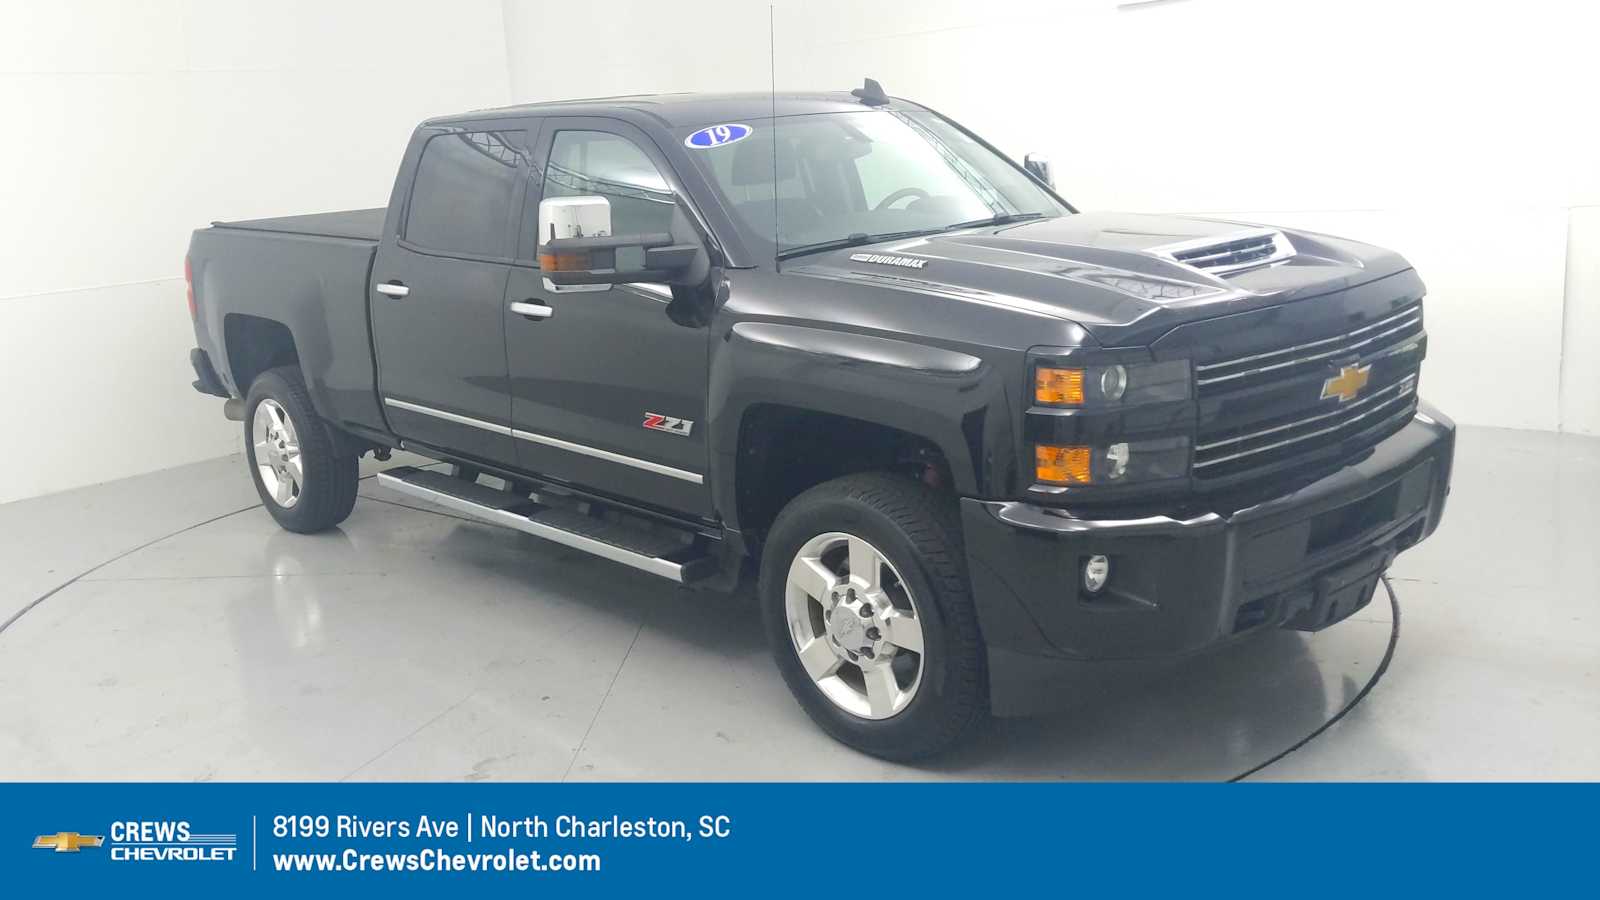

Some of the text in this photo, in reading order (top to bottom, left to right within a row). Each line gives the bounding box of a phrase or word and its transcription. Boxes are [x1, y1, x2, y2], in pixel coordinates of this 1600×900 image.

[705, 125, 731, 146] 19
[867, 254, 928, 269] DURAMAX
[642, 411, 694, 437] Z71
